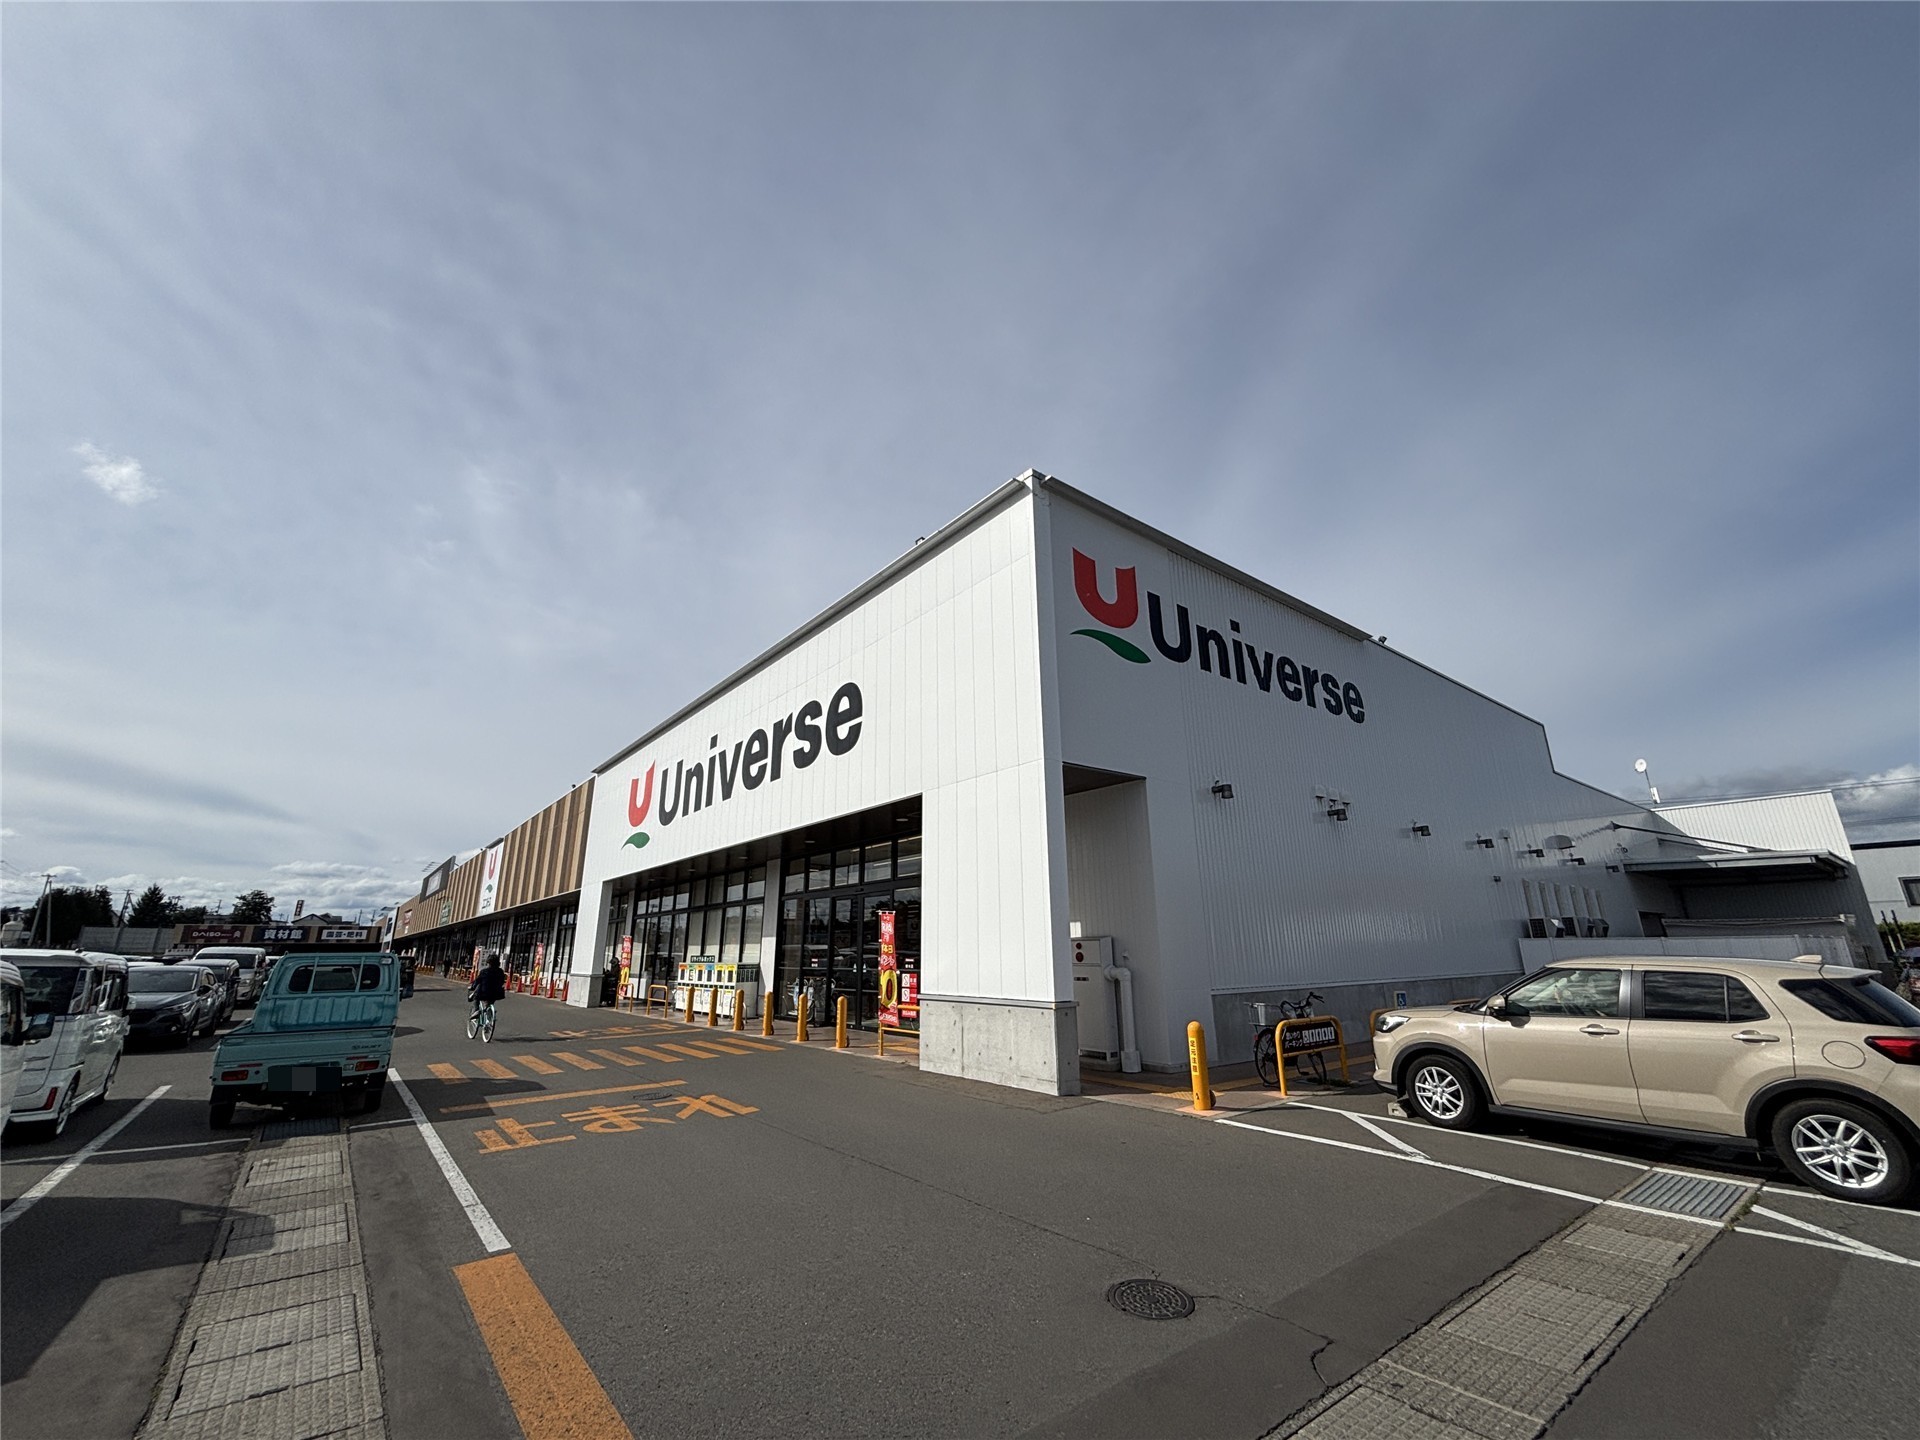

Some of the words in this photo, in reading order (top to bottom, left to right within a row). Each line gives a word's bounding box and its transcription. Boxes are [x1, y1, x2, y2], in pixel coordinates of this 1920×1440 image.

[1146, 590, 1366, 725] Universe
[658, 681, 863, 827] Universe
[263, 928, 303, 939] 資材館
[473, 1094, 760, 1154] 止まれ
